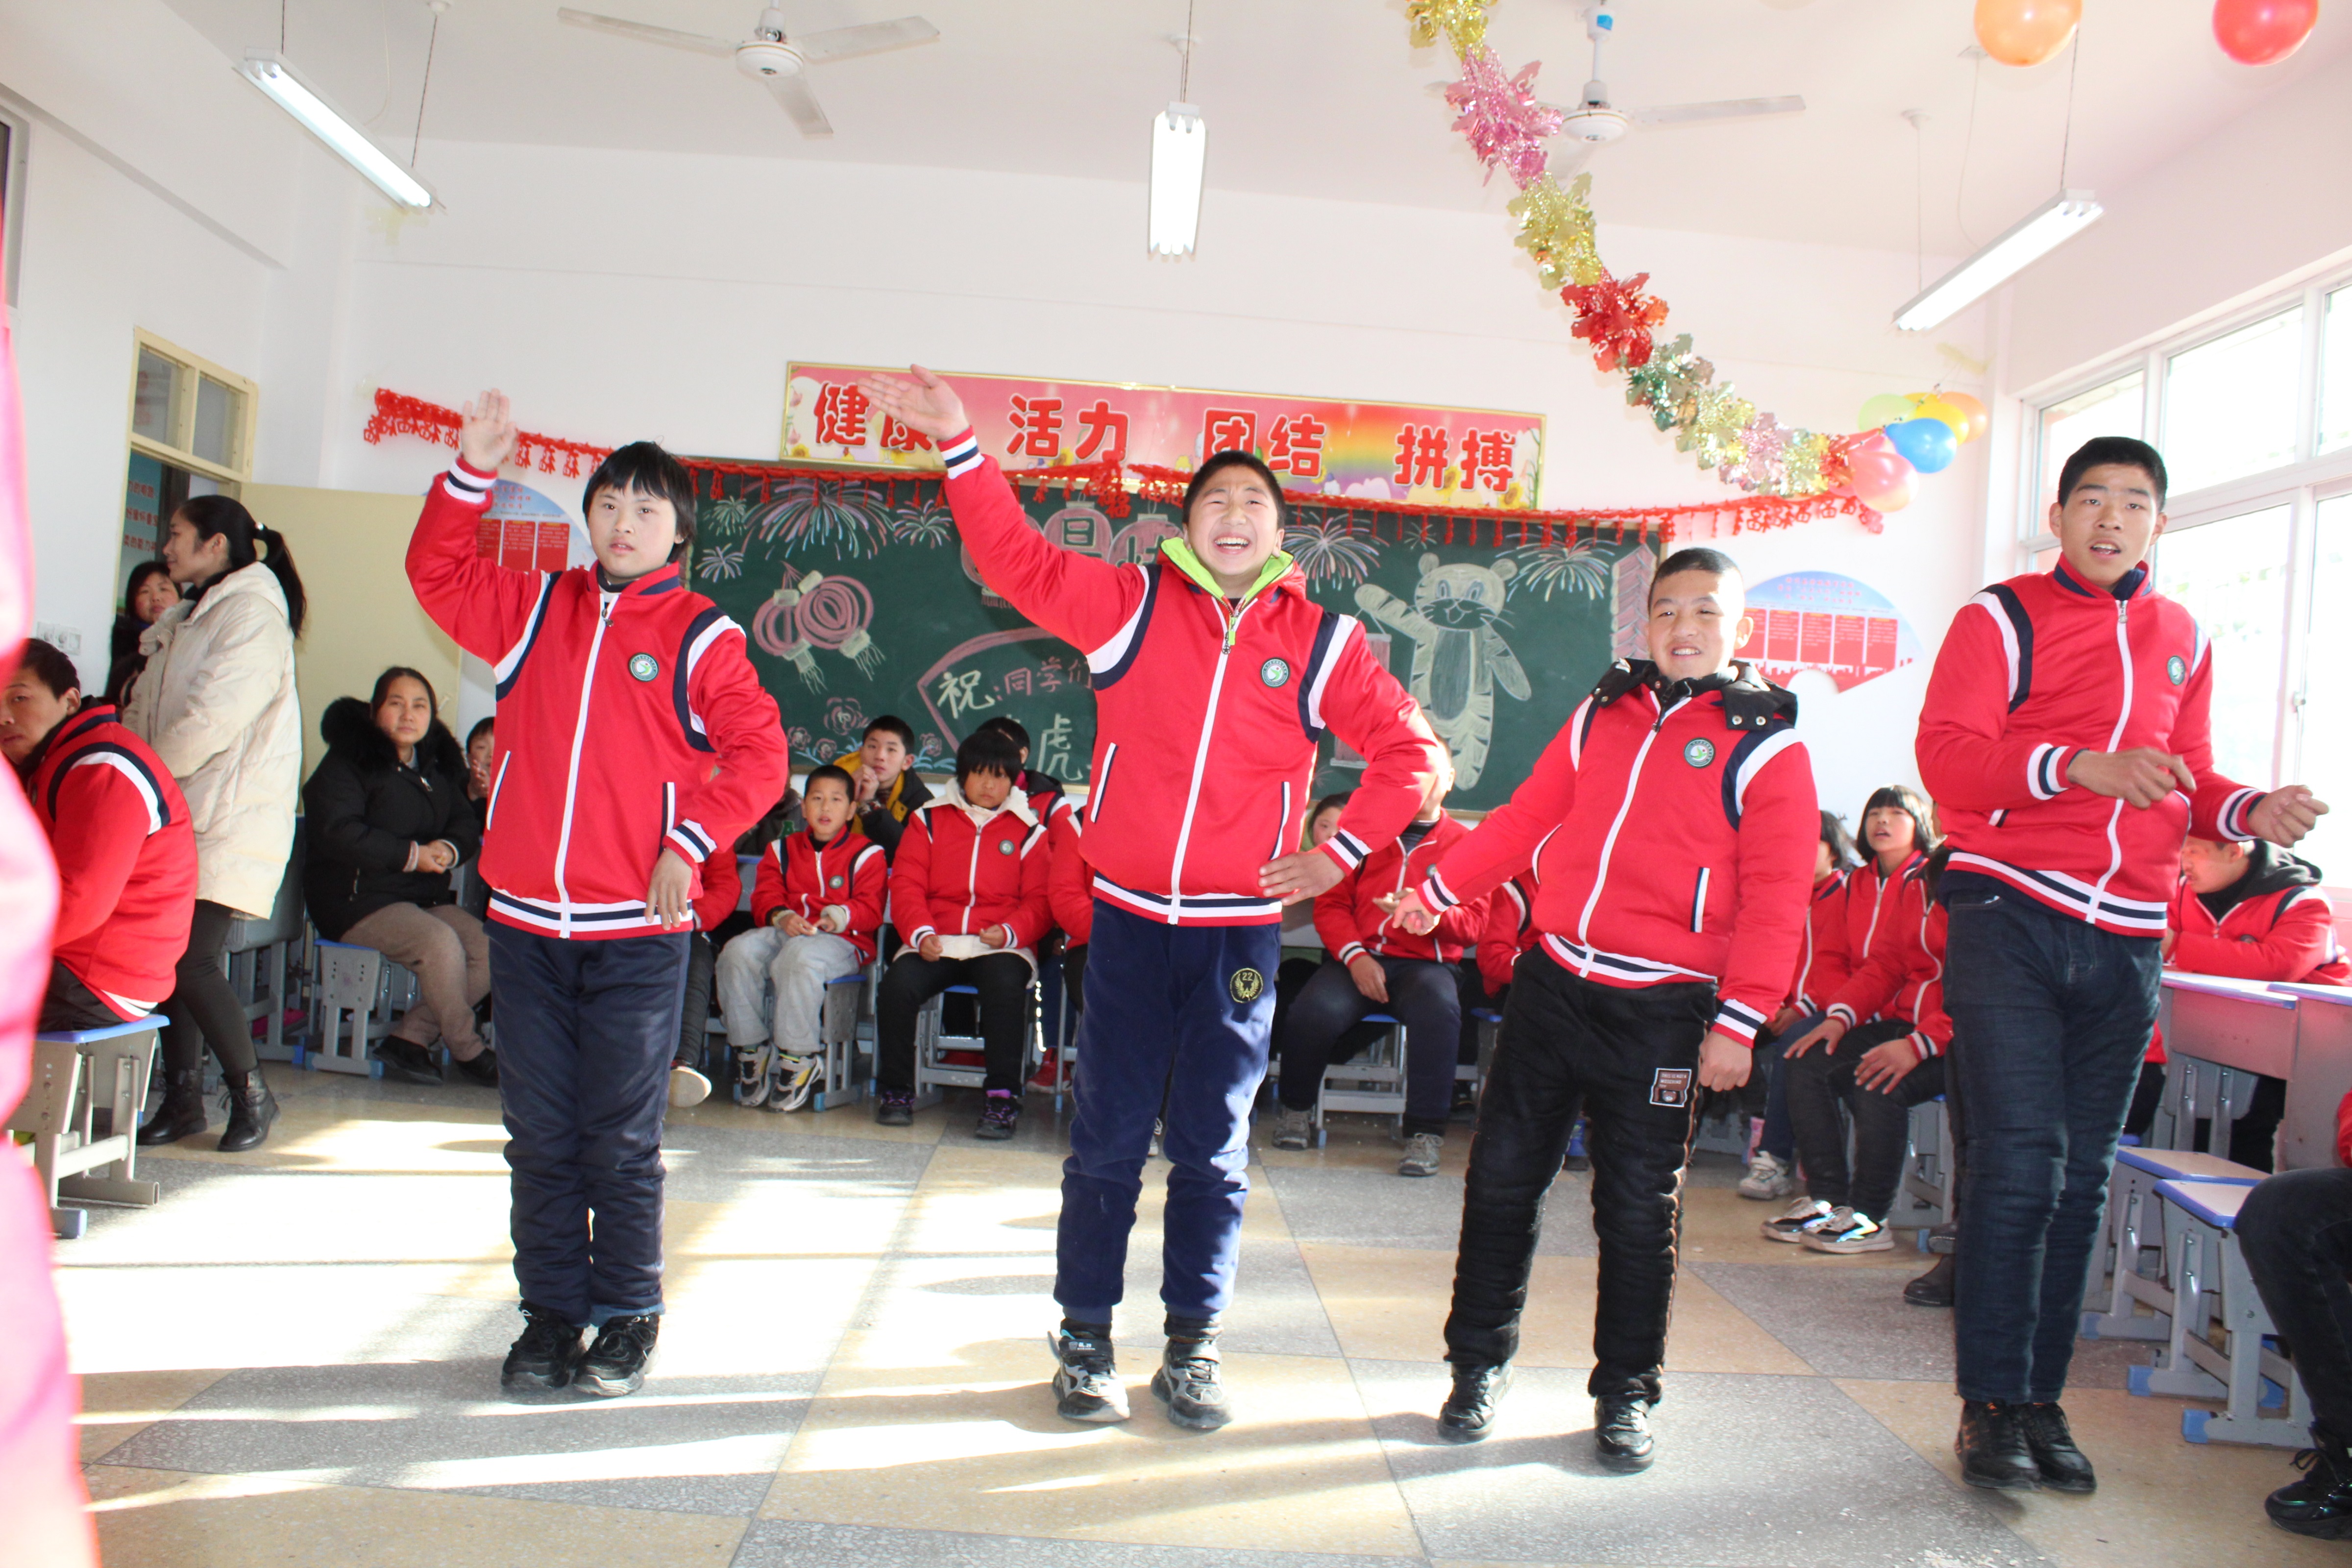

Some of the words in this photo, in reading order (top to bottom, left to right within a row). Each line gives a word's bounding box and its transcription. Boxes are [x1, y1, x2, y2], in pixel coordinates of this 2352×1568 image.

[1007, 394, 1129, 462] 活力
[1201, 407, 1326, 478] 团结
[1394, 425, 1516, 493] 拼搏
[1242, 972, 1253, 981] 22
